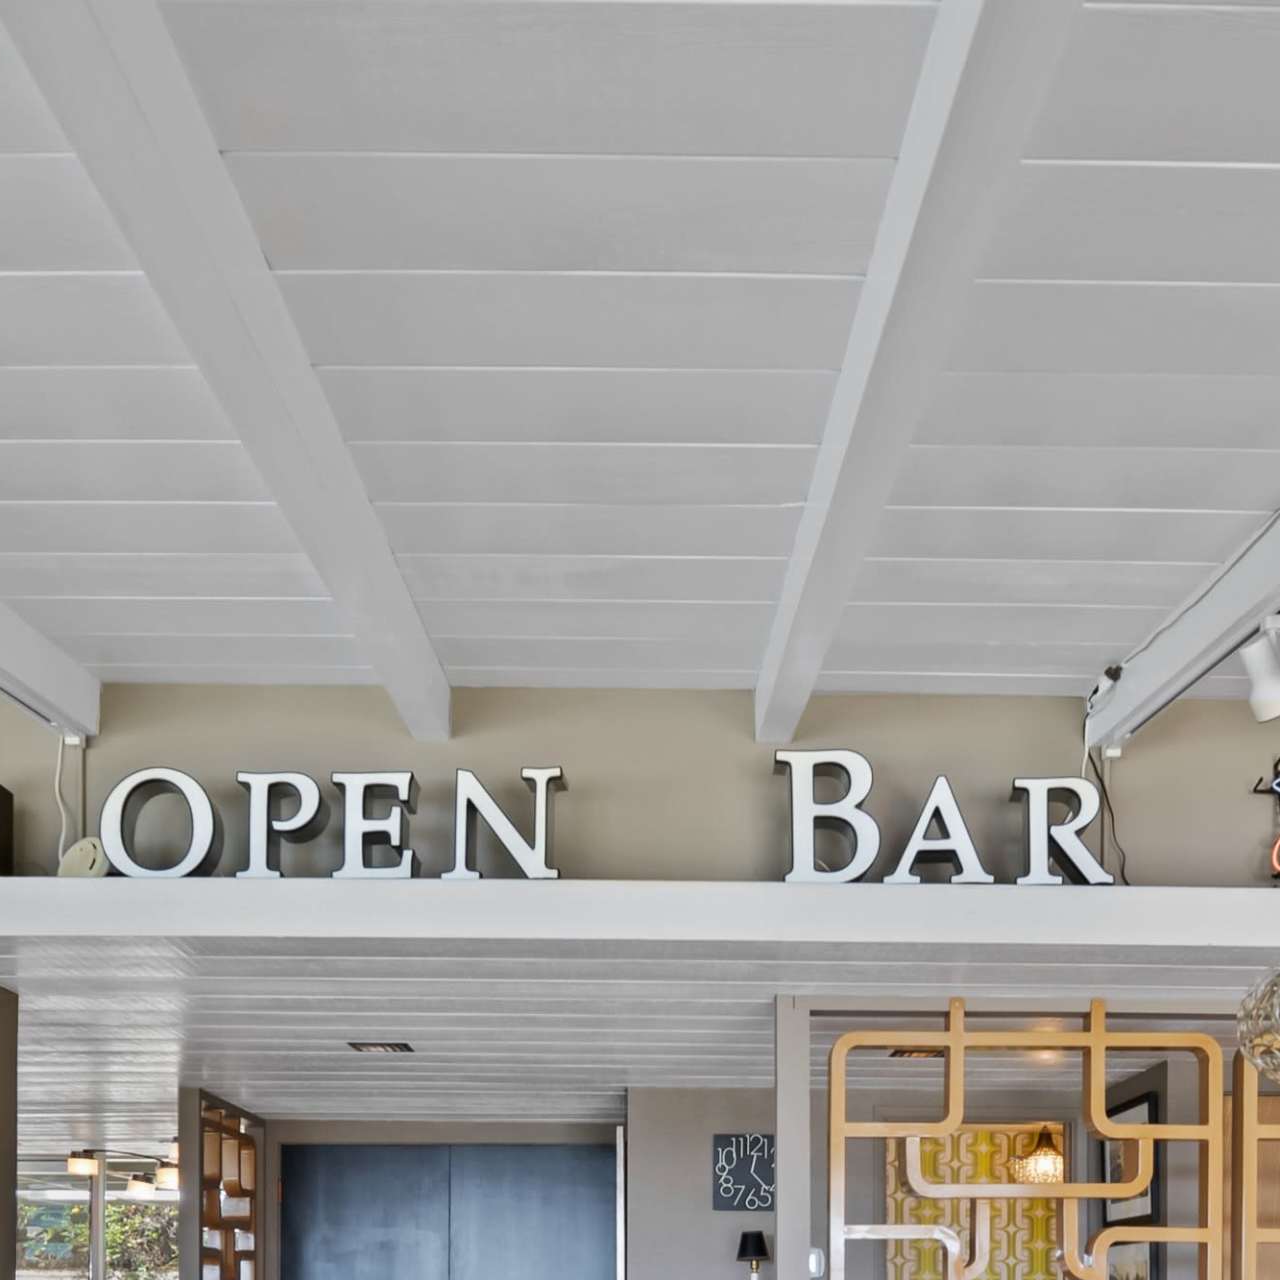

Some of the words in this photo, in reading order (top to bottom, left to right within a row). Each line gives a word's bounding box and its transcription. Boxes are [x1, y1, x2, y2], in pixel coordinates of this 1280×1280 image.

[99, 765, 564, 880] OPEN
[772, 748, 1115, 886] BAR
[731, 1137, 743, 1158] 11
[745, 1134, 763, 1155] 12
[717, 1147, 736, 1169] 10
[715, 1162, 729, 1184] 9
[719, 1175, 734, 1197] 8
[733, 1185, 746, 1206] 7
[758, 1186, 772, 1207] 5
[745, 1187, 759, 1209] 6
